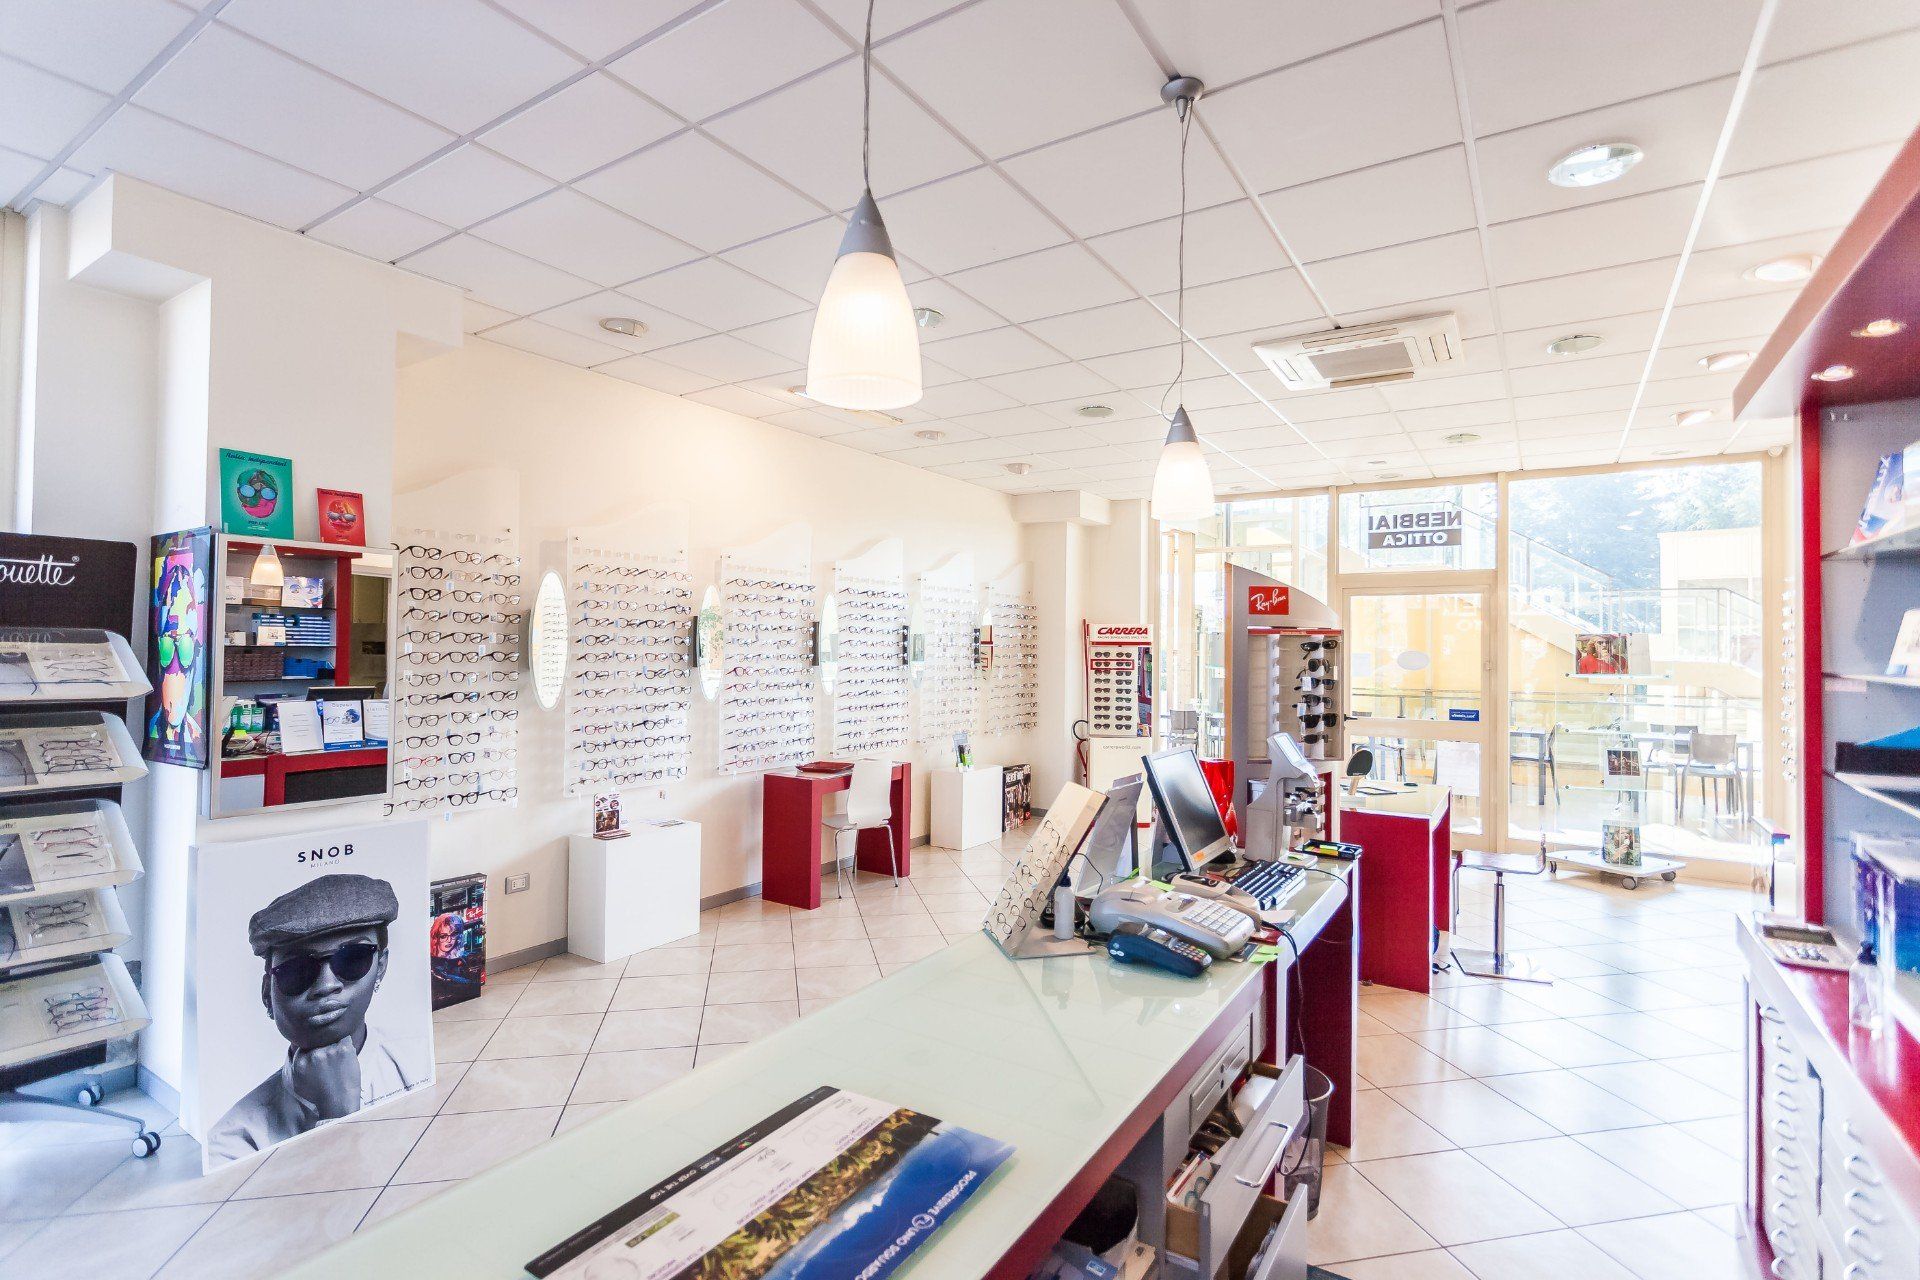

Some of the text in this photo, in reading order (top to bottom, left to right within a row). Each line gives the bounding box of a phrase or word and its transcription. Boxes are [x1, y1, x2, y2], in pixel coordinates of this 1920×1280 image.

[1250, 588, 1287, 612] Ray-Ban
[1097, 627, 1148, 635] CARRERA
[297, 844, 354, 863] SNOB
[310, 859, 340, 869] MILANO
[896, 1226, 920, 1246] UNO
